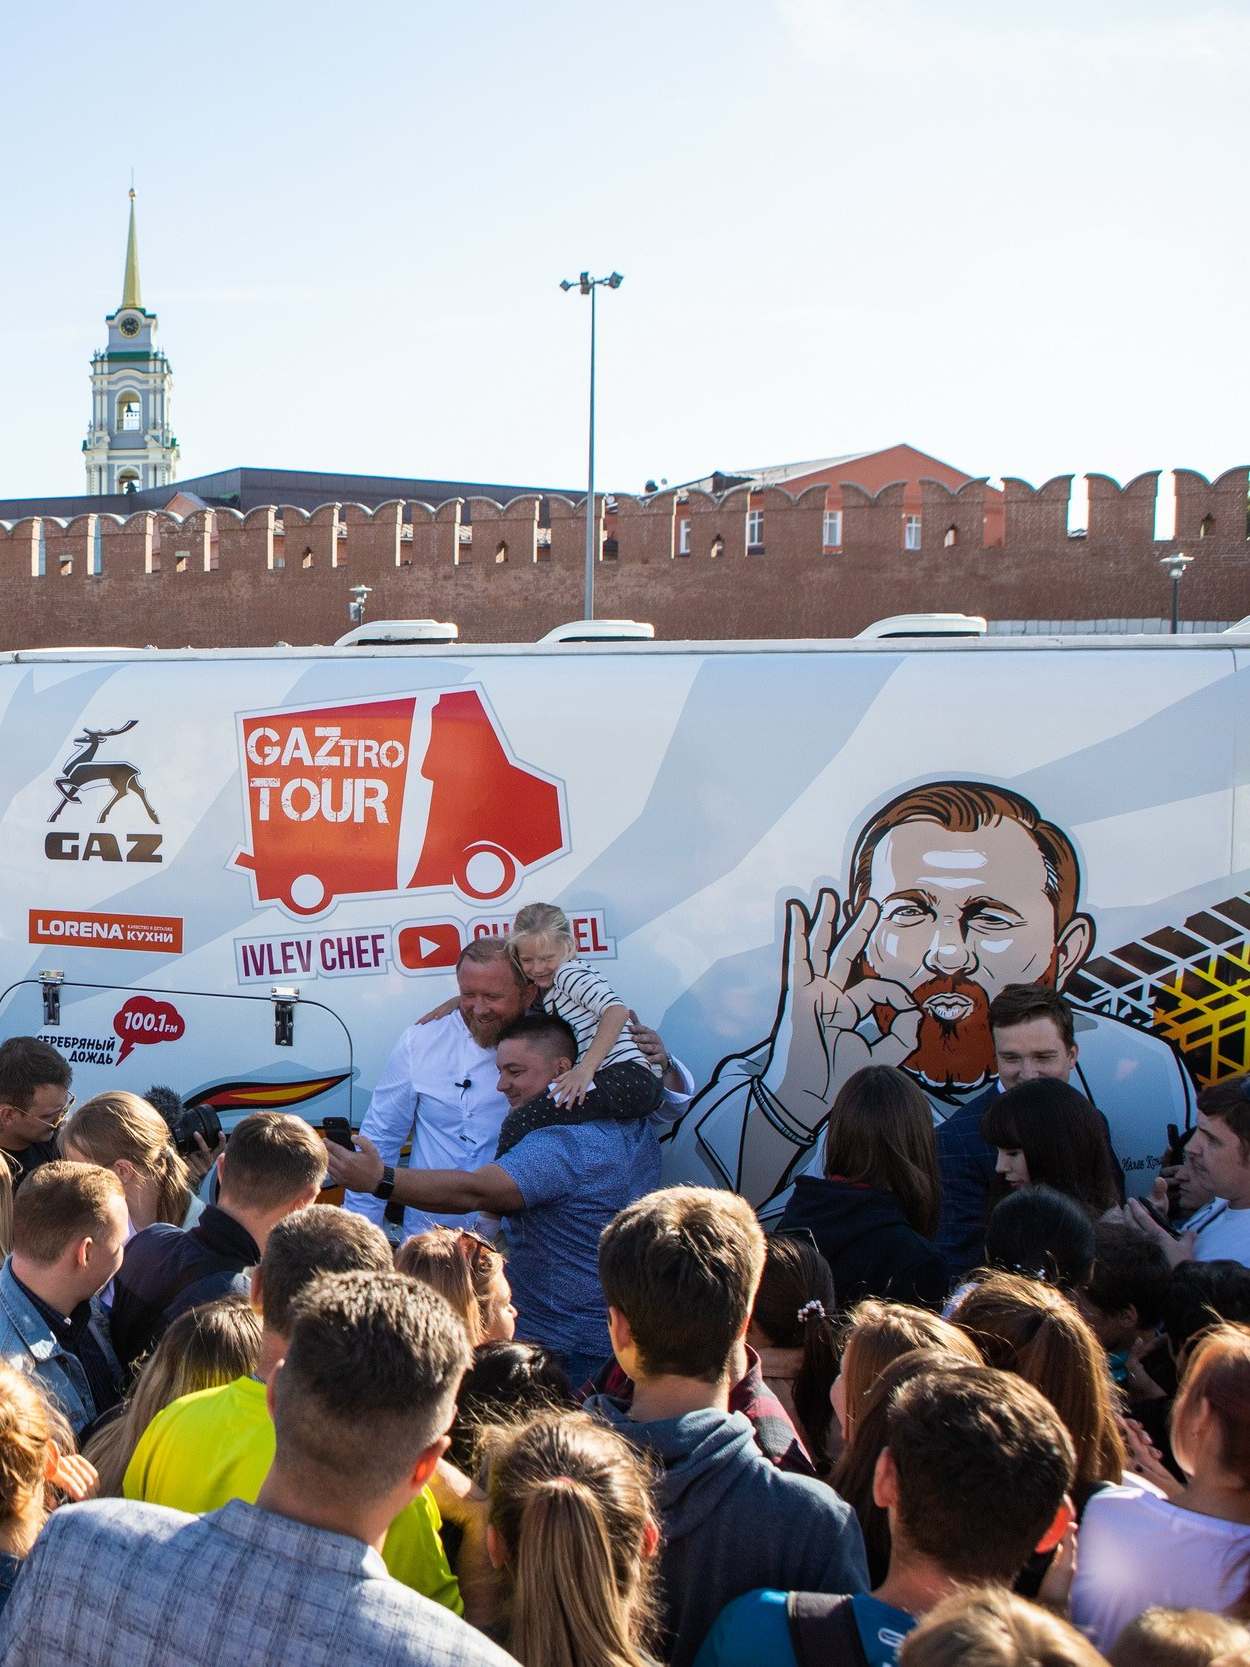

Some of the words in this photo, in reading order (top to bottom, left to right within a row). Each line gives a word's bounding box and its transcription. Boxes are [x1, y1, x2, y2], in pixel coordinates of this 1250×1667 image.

[246, 726, 406, 768] GAZTRO
[249, 777, 390, 824] TOUR
[44, 832, 163, 863] GAZ
[37, 919, 124, 940] LORENA
[127, 930, 174, 943] КУХНИ
[241, 939, 312, 977] IVLEV
[320, 933, 385, 971] CHEF
[68, 1050, 114, 1065] ДОЖДЬ
